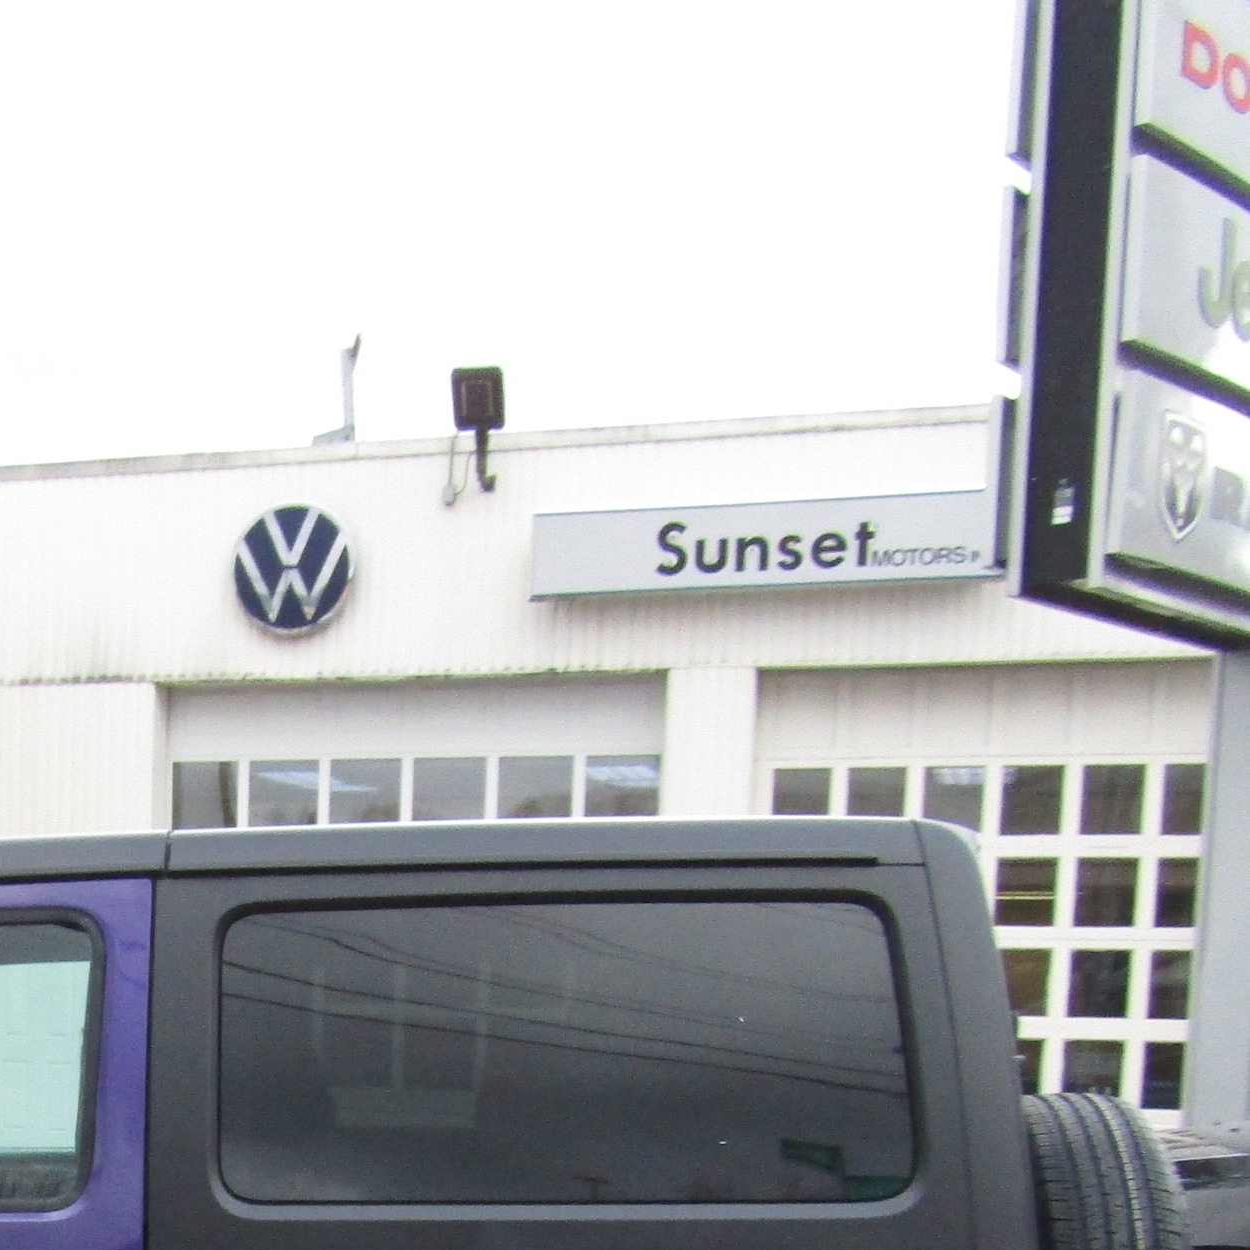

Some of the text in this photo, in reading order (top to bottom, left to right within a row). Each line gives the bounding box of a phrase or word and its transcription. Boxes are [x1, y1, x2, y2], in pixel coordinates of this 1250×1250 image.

[234, 503, 350, 630] VW
[656, 521, 967, 576] Sunset MOTORS
